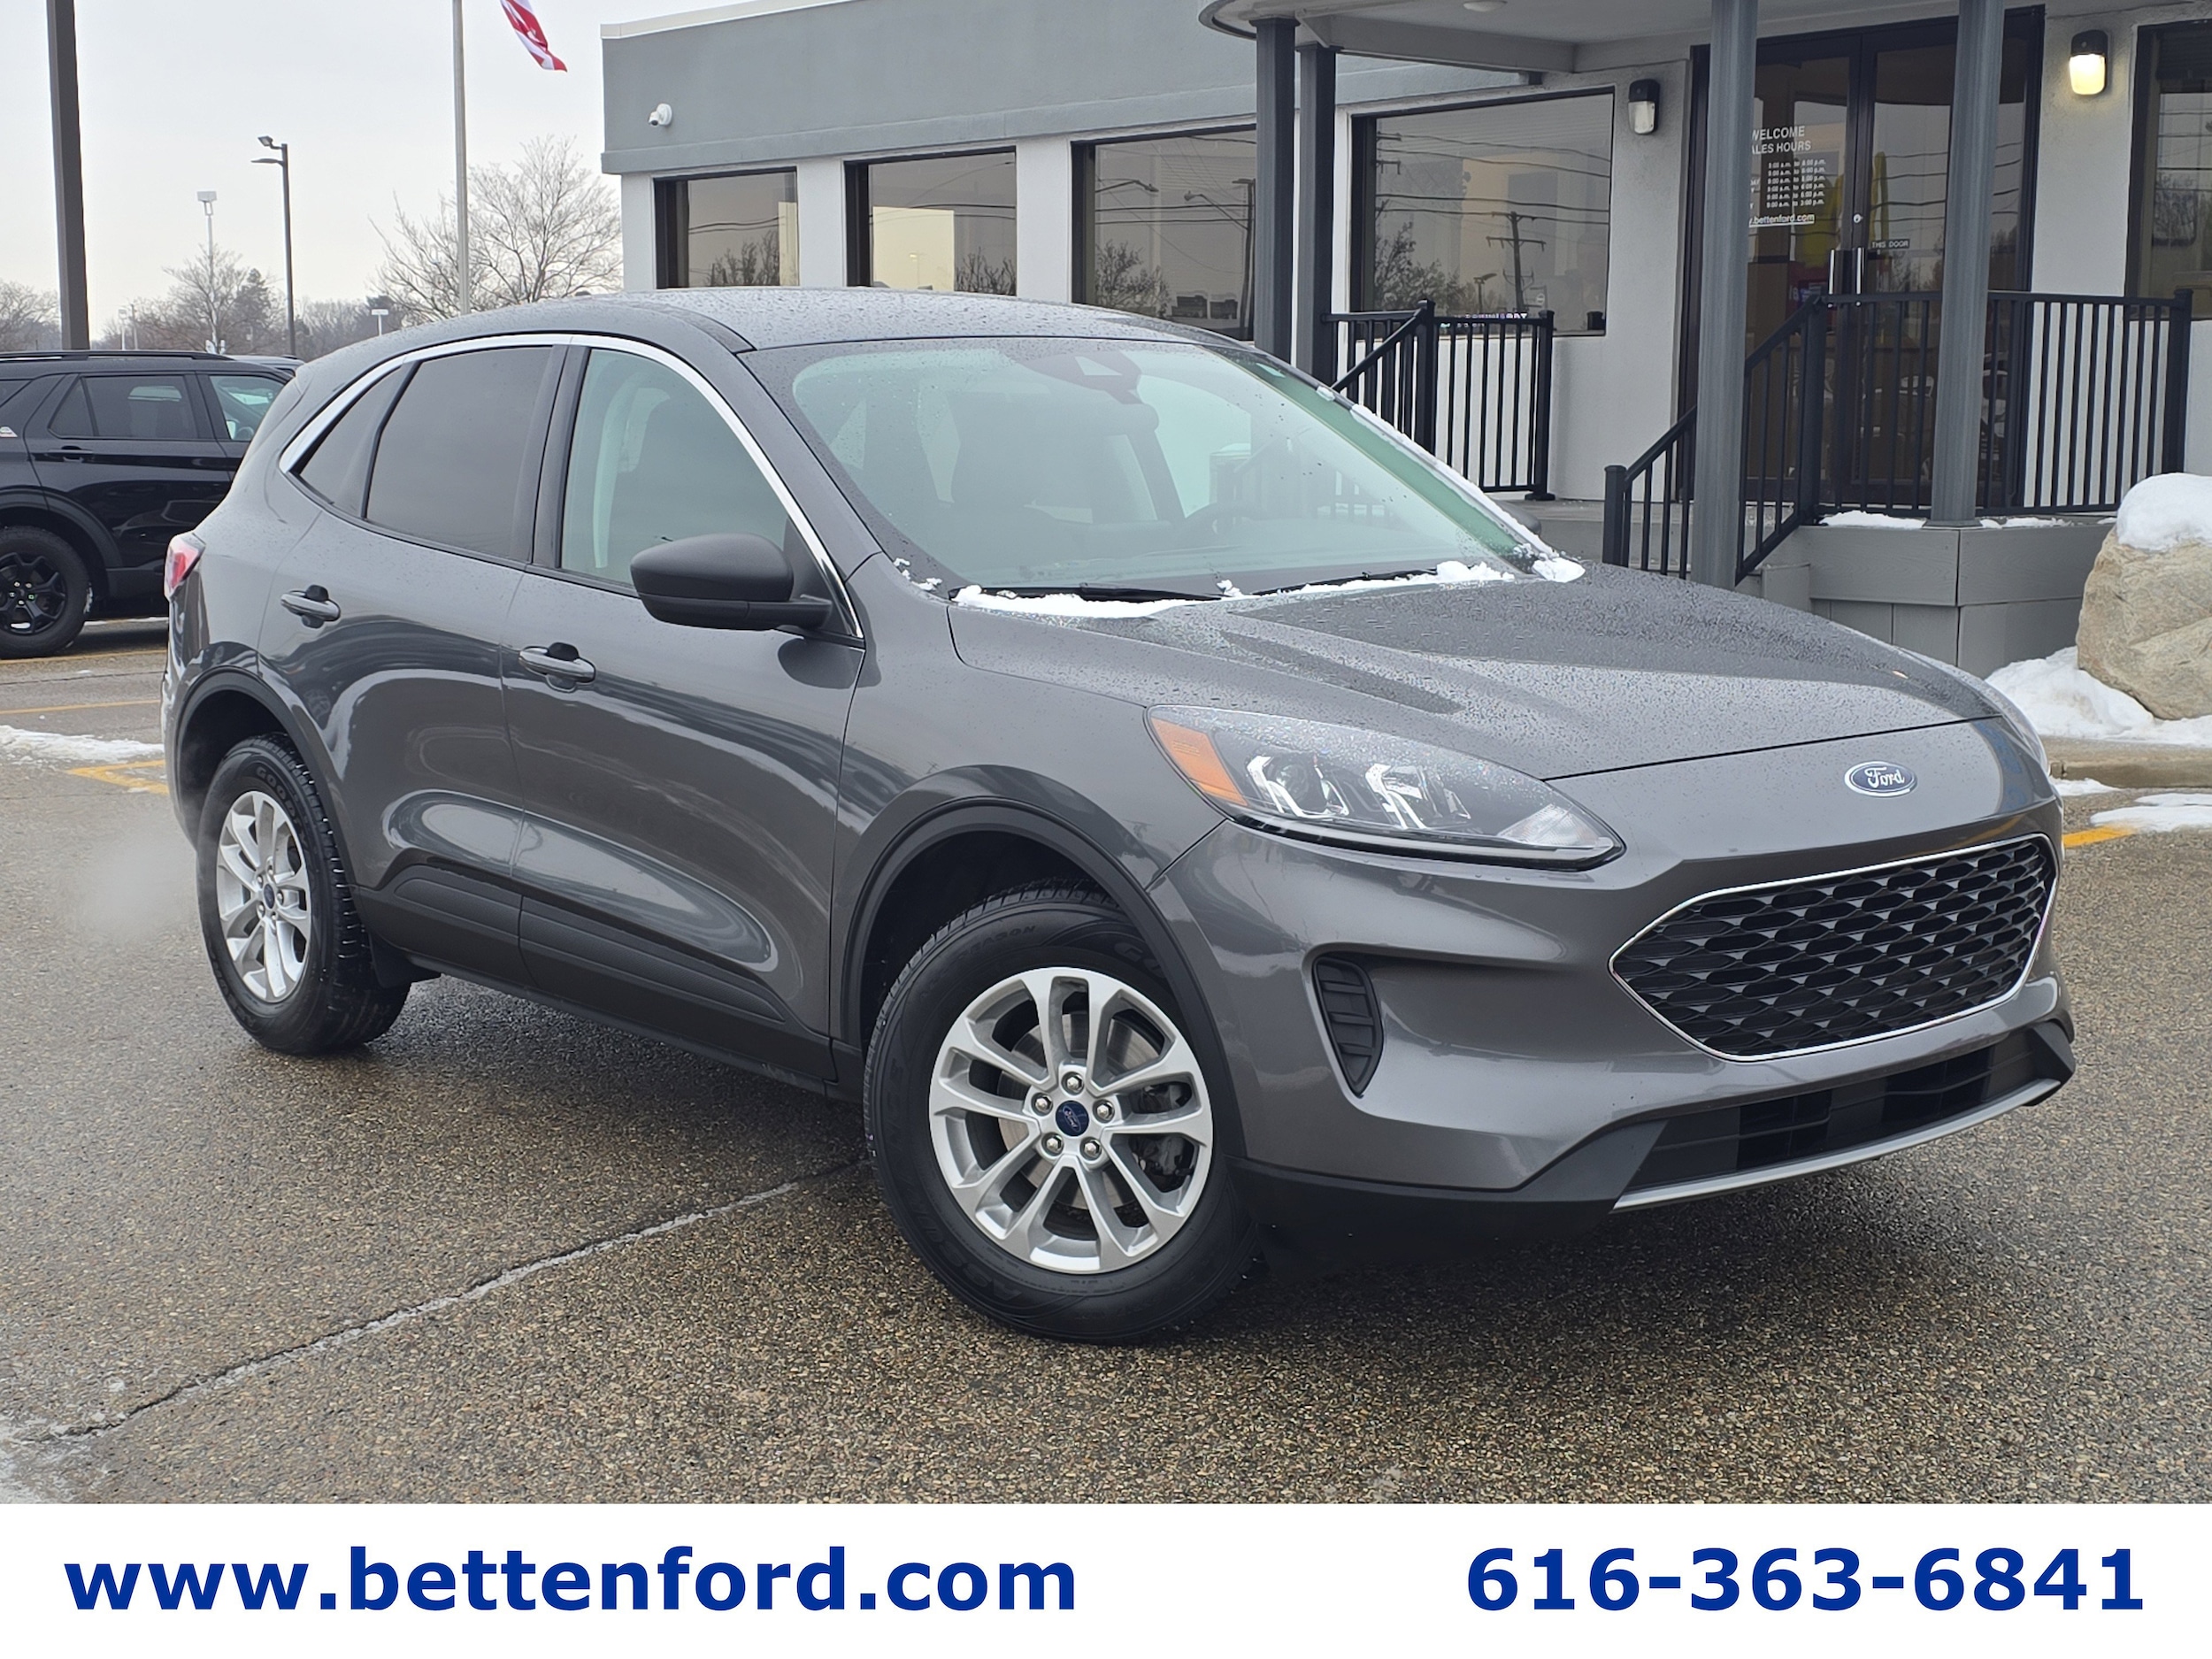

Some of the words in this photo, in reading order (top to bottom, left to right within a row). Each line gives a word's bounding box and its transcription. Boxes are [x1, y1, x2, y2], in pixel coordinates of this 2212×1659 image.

[1752, 125, 1805, 141] WELCOME
[1752, 143, 1775, 155] LES
[1776, 140, 1811, 153] HOURS
[1749, 214, 1815, 225] .bettenford.com
[1864, 766, 1905, 788] Ford
